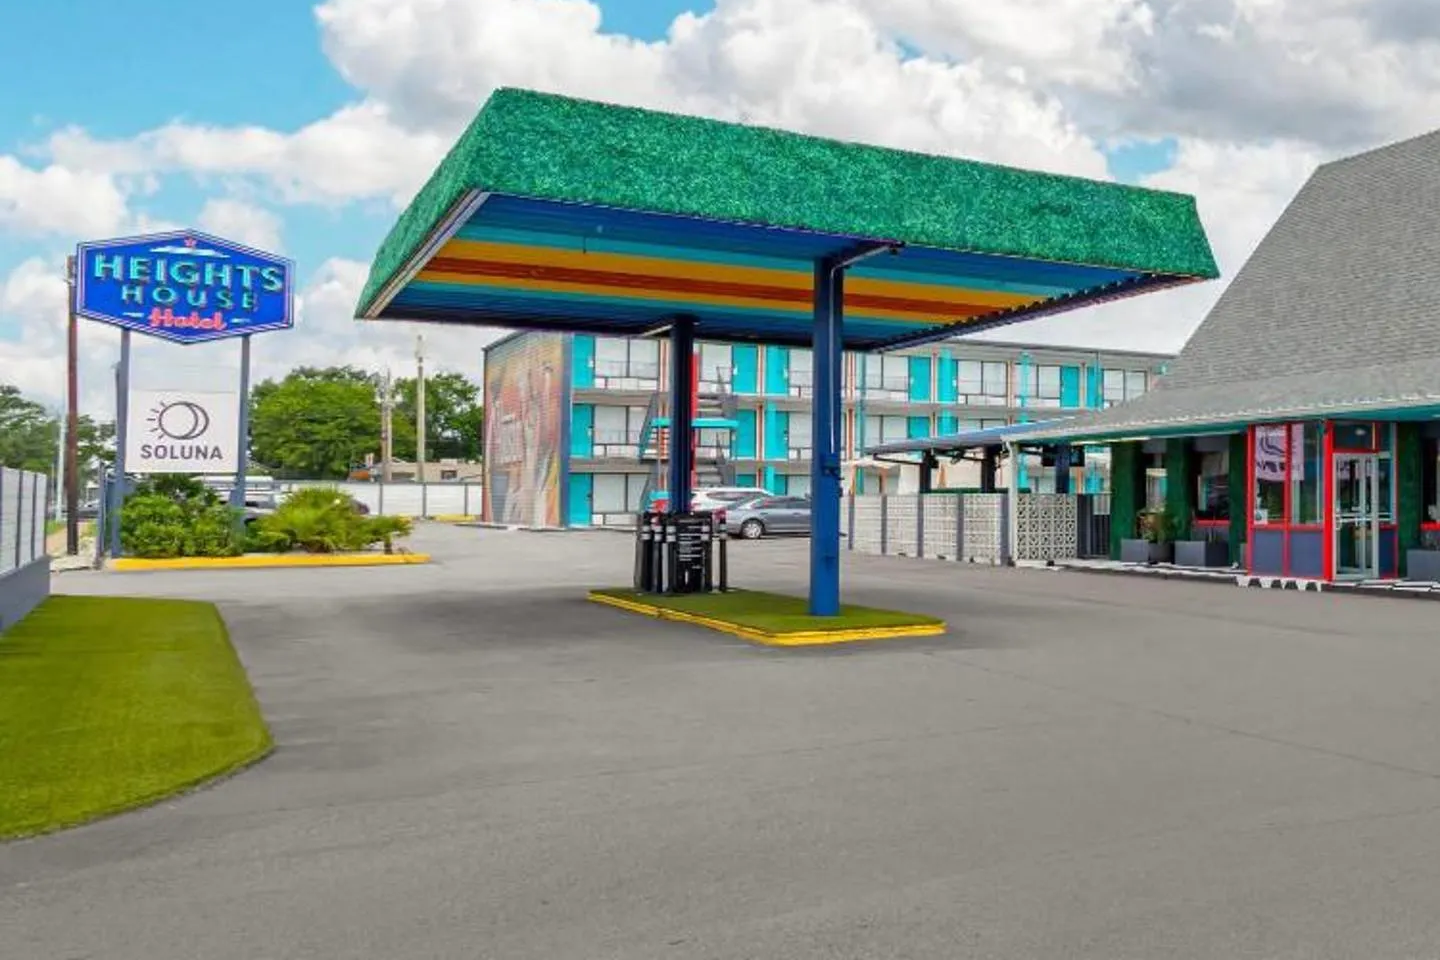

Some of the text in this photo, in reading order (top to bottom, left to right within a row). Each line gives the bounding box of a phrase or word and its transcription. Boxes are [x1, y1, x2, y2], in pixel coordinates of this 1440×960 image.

[94, 253, 284, 292] HEIGHTS
[121, 284, 259, 312] HOUSE
[149, 306, 227, 330] Hotel
[140, 444, 223, 460] SOLUNA
